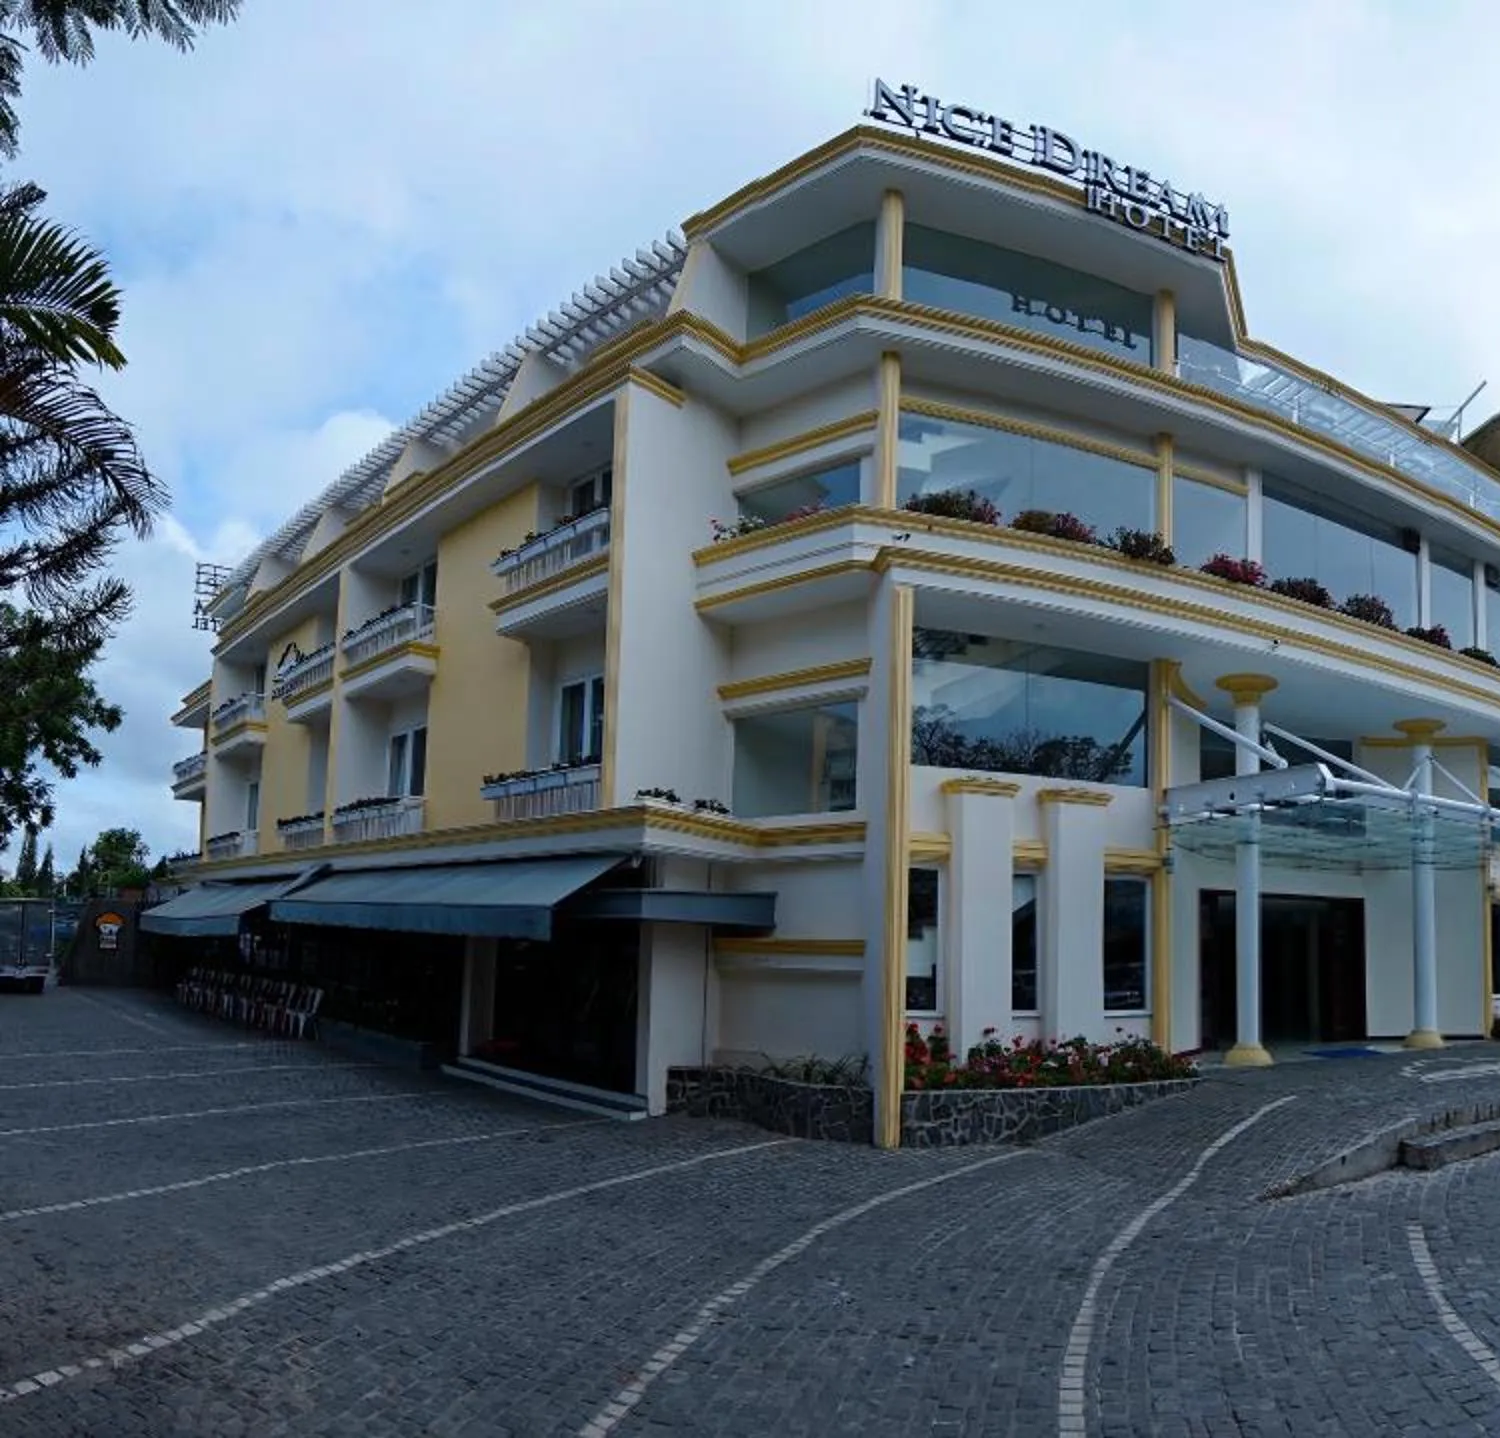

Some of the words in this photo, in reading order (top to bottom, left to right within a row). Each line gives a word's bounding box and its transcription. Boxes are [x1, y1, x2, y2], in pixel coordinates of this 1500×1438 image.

[869, 77, 1014, 157] NICE
[1029, 124, 1230, 239] DREAM
[1085, 184, 1226, 262] HOTEL
